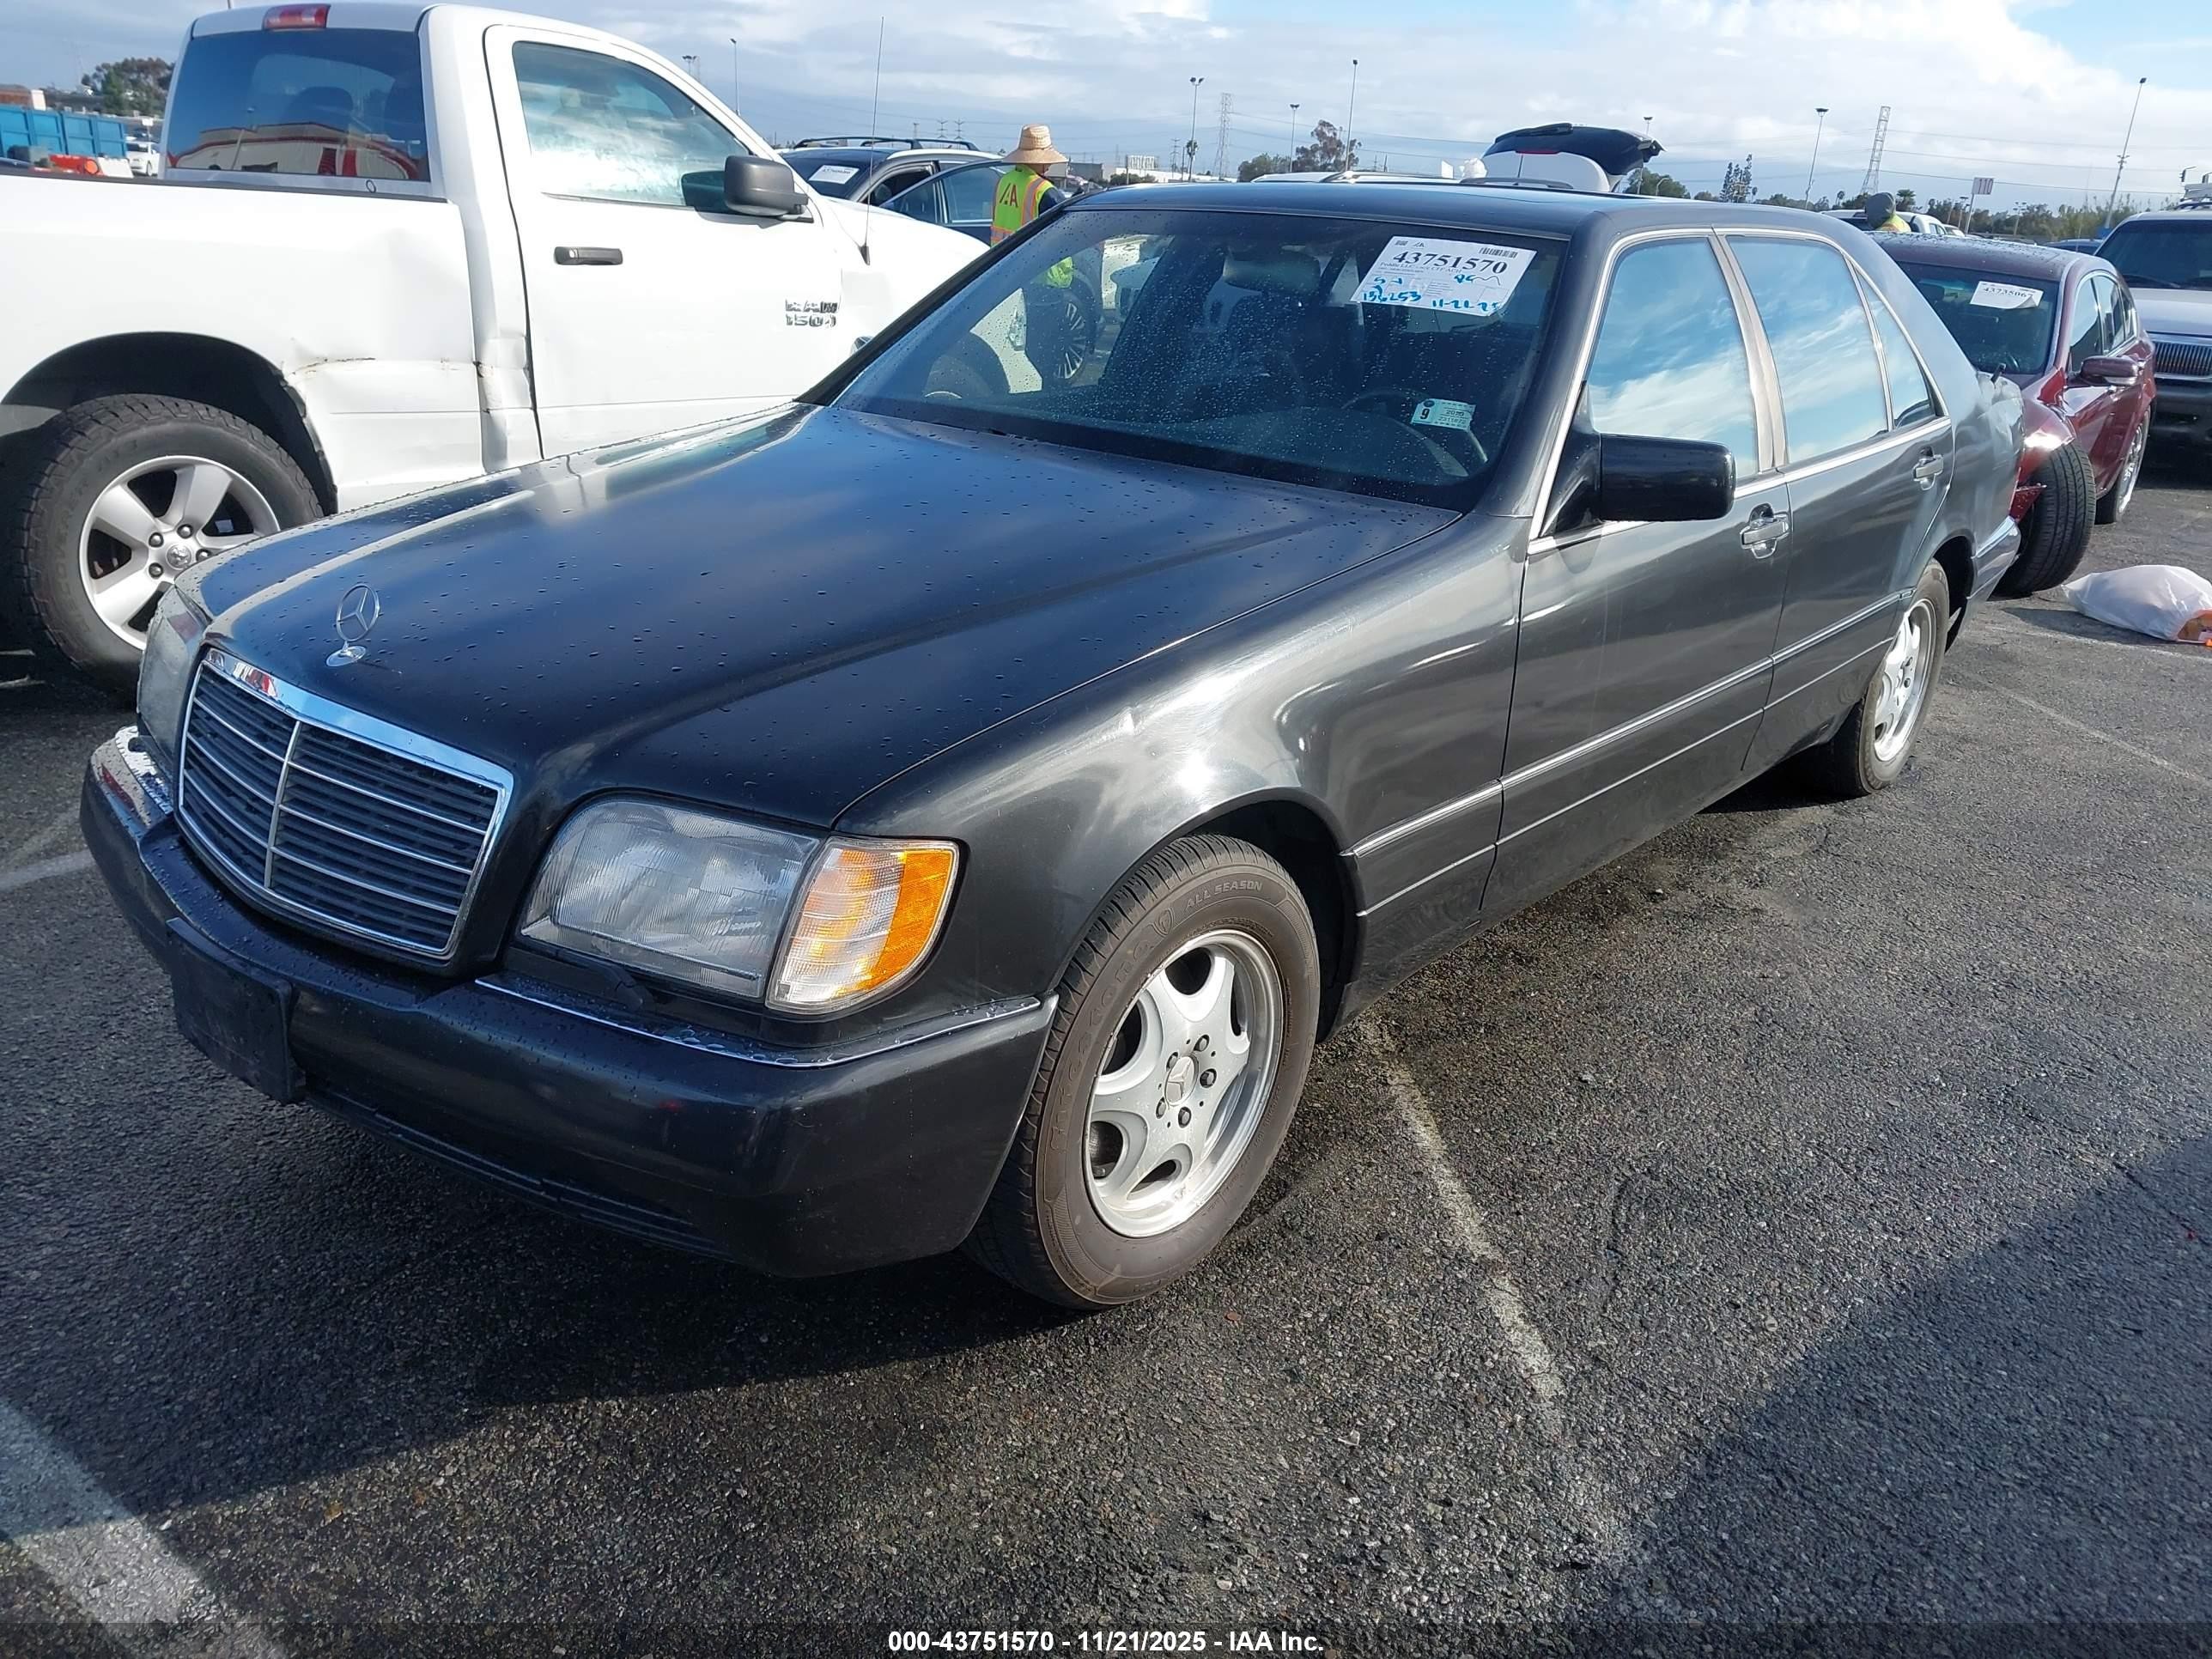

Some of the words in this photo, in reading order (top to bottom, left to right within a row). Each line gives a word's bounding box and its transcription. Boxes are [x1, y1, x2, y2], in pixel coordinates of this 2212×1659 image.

[1393, 251, 1509, 274] 43751570
[1419, 408, 1431, 420] 9
[1186, 890, 1212, 908] ALL
[1214, 880, 1263, 895] SEASON
